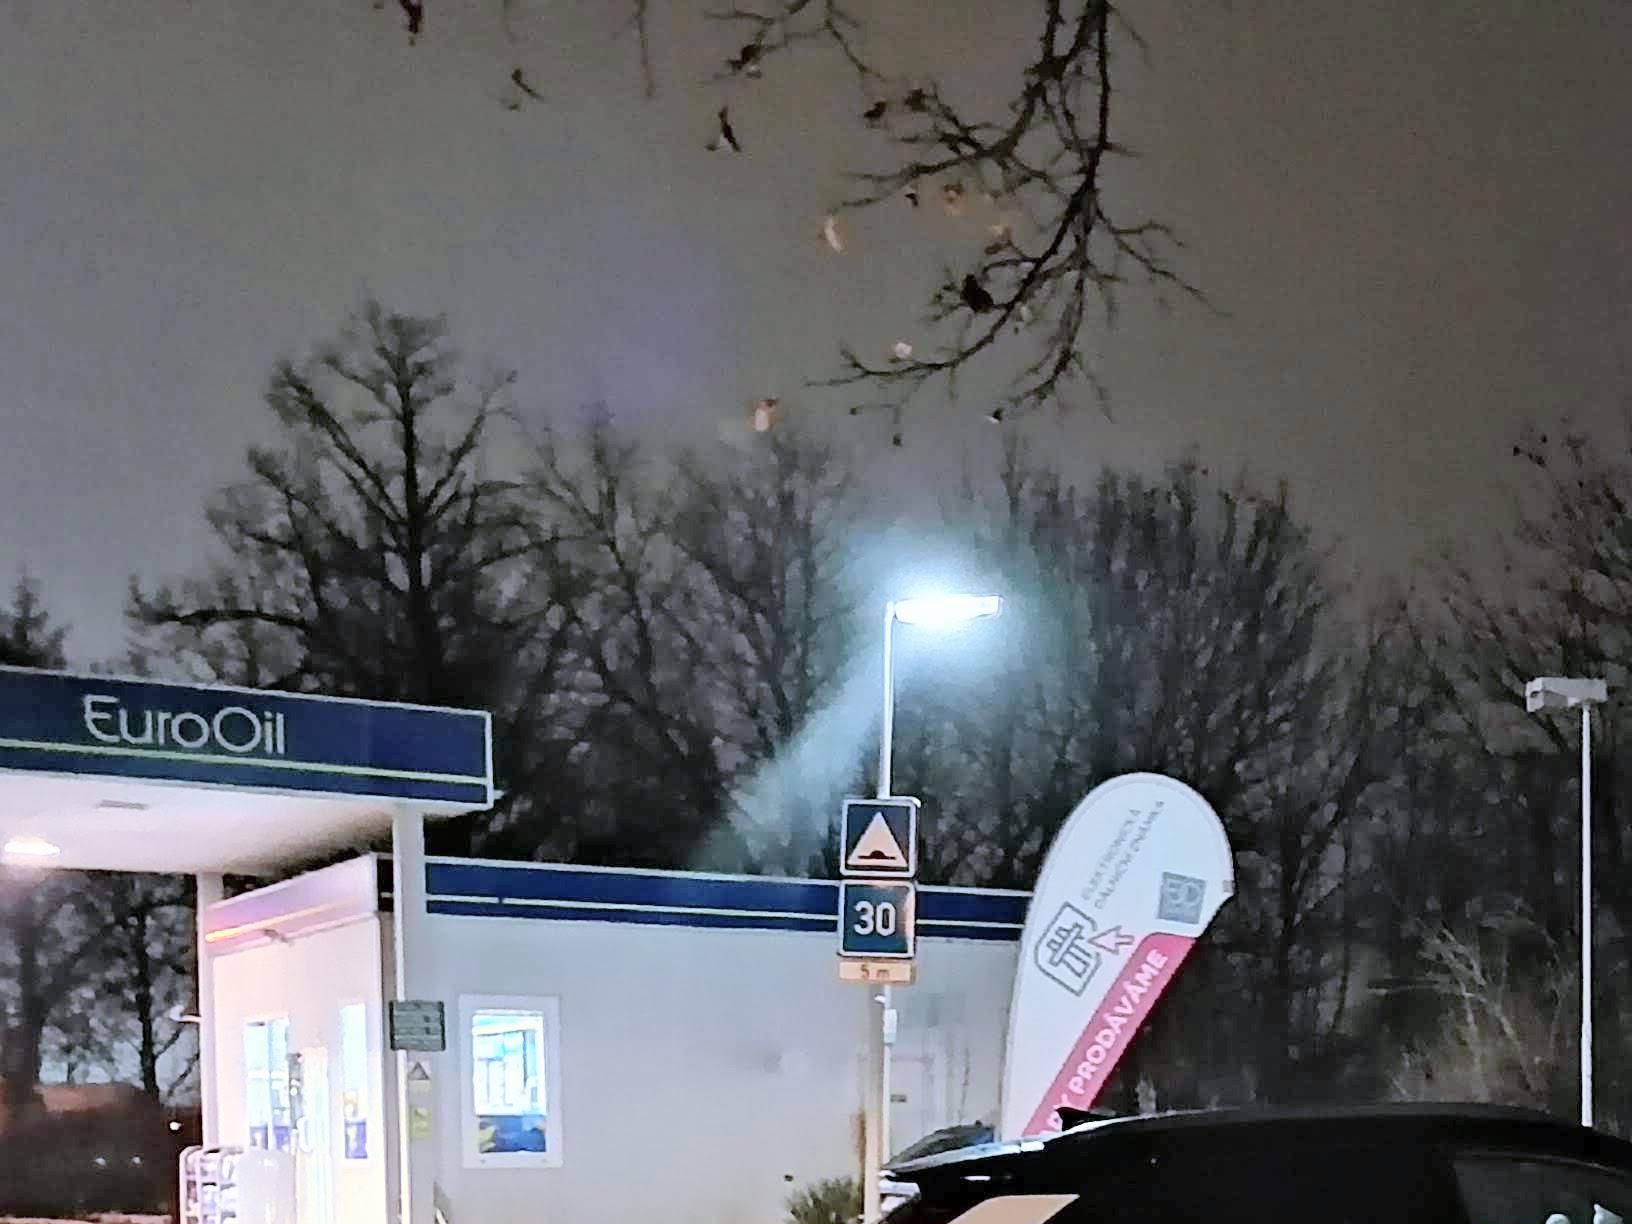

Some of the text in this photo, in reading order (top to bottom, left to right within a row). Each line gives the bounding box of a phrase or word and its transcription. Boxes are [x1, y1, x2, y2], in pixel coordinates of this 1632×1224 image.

[83, 694, 285, 755] EuroOil
[854, 900, 896, 936] 30
[1068, 949, 1169, 1094] PRODÁVÁME
